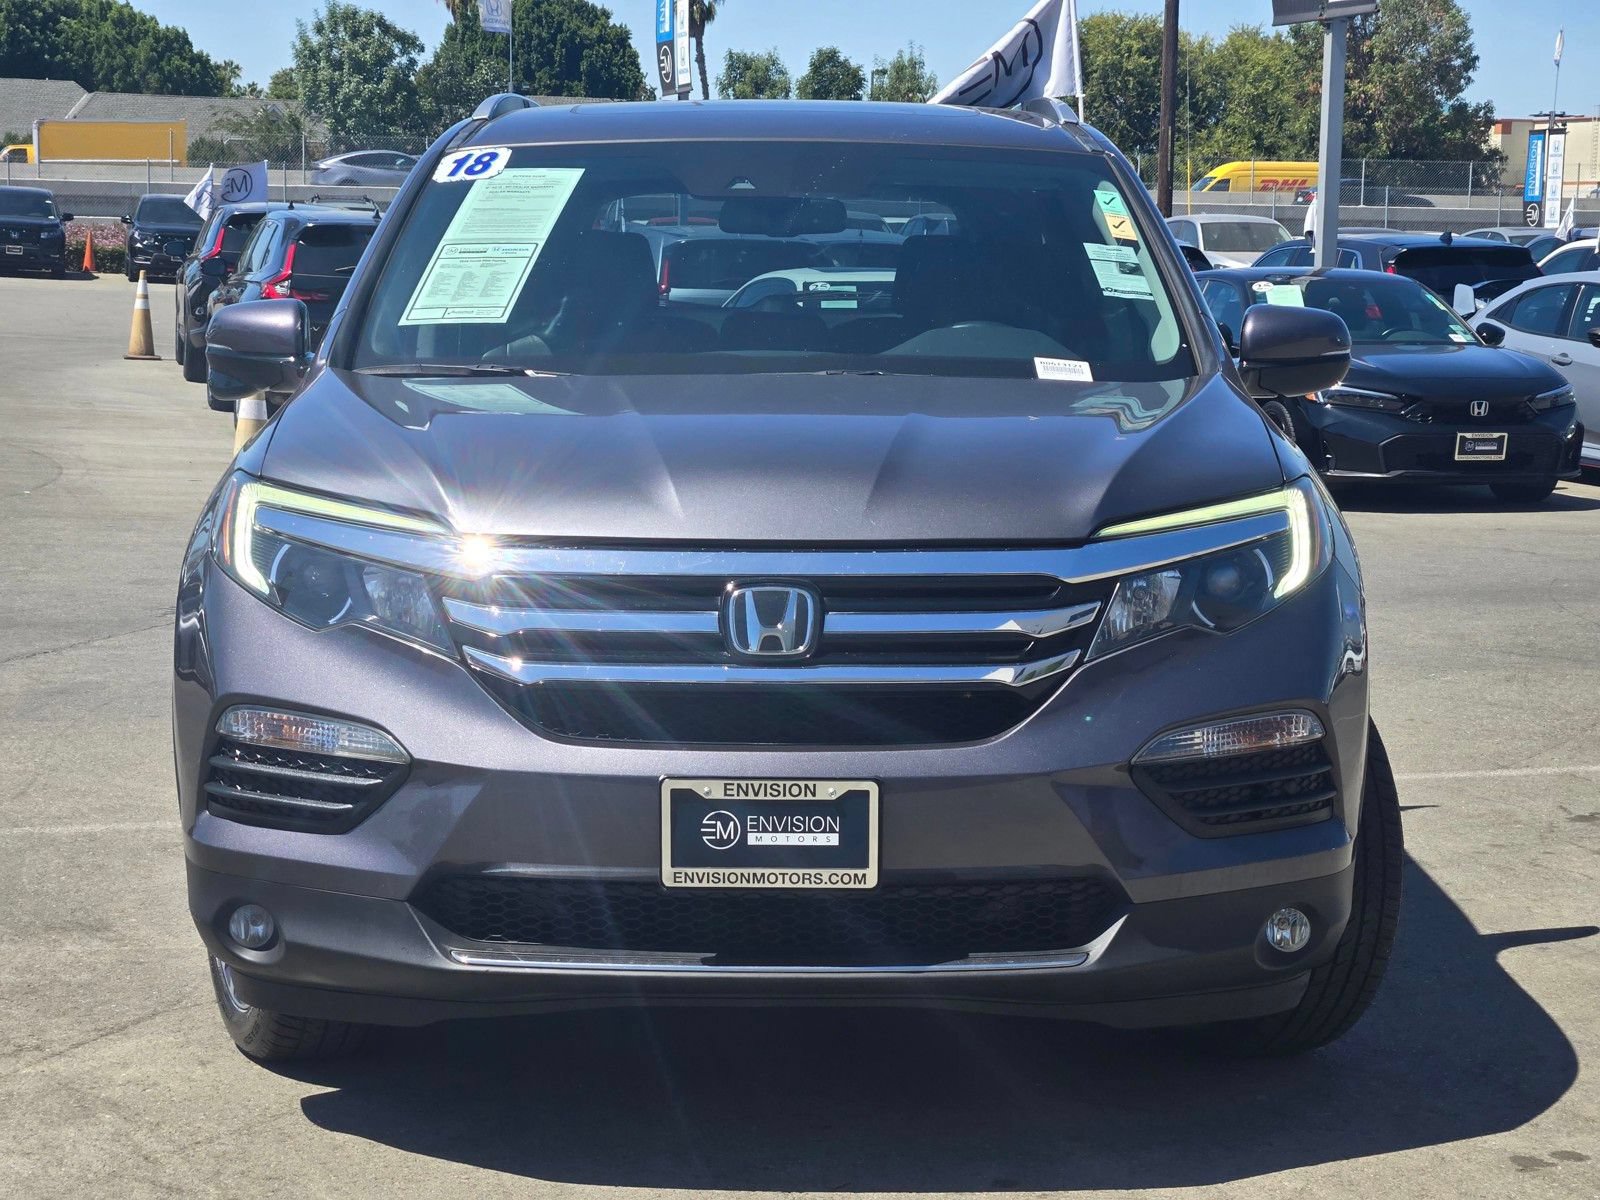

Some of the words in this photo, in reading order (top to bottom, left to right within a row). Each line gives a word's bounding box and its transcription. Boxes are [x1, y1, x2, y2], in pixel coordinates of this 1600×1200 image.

[447, 151, 500, 177] 18
[1528, 140, 1538, 196] ENVISION
[1259, 178, 1309, 192] DHL
[723, 782, 817, 798] ENVISION
[747, 815, 840, 832] ENVISION
[755, 835, 832, 843] MOTORS
[673, 871, 867, 885] ENVISIONMOTORS.COM
